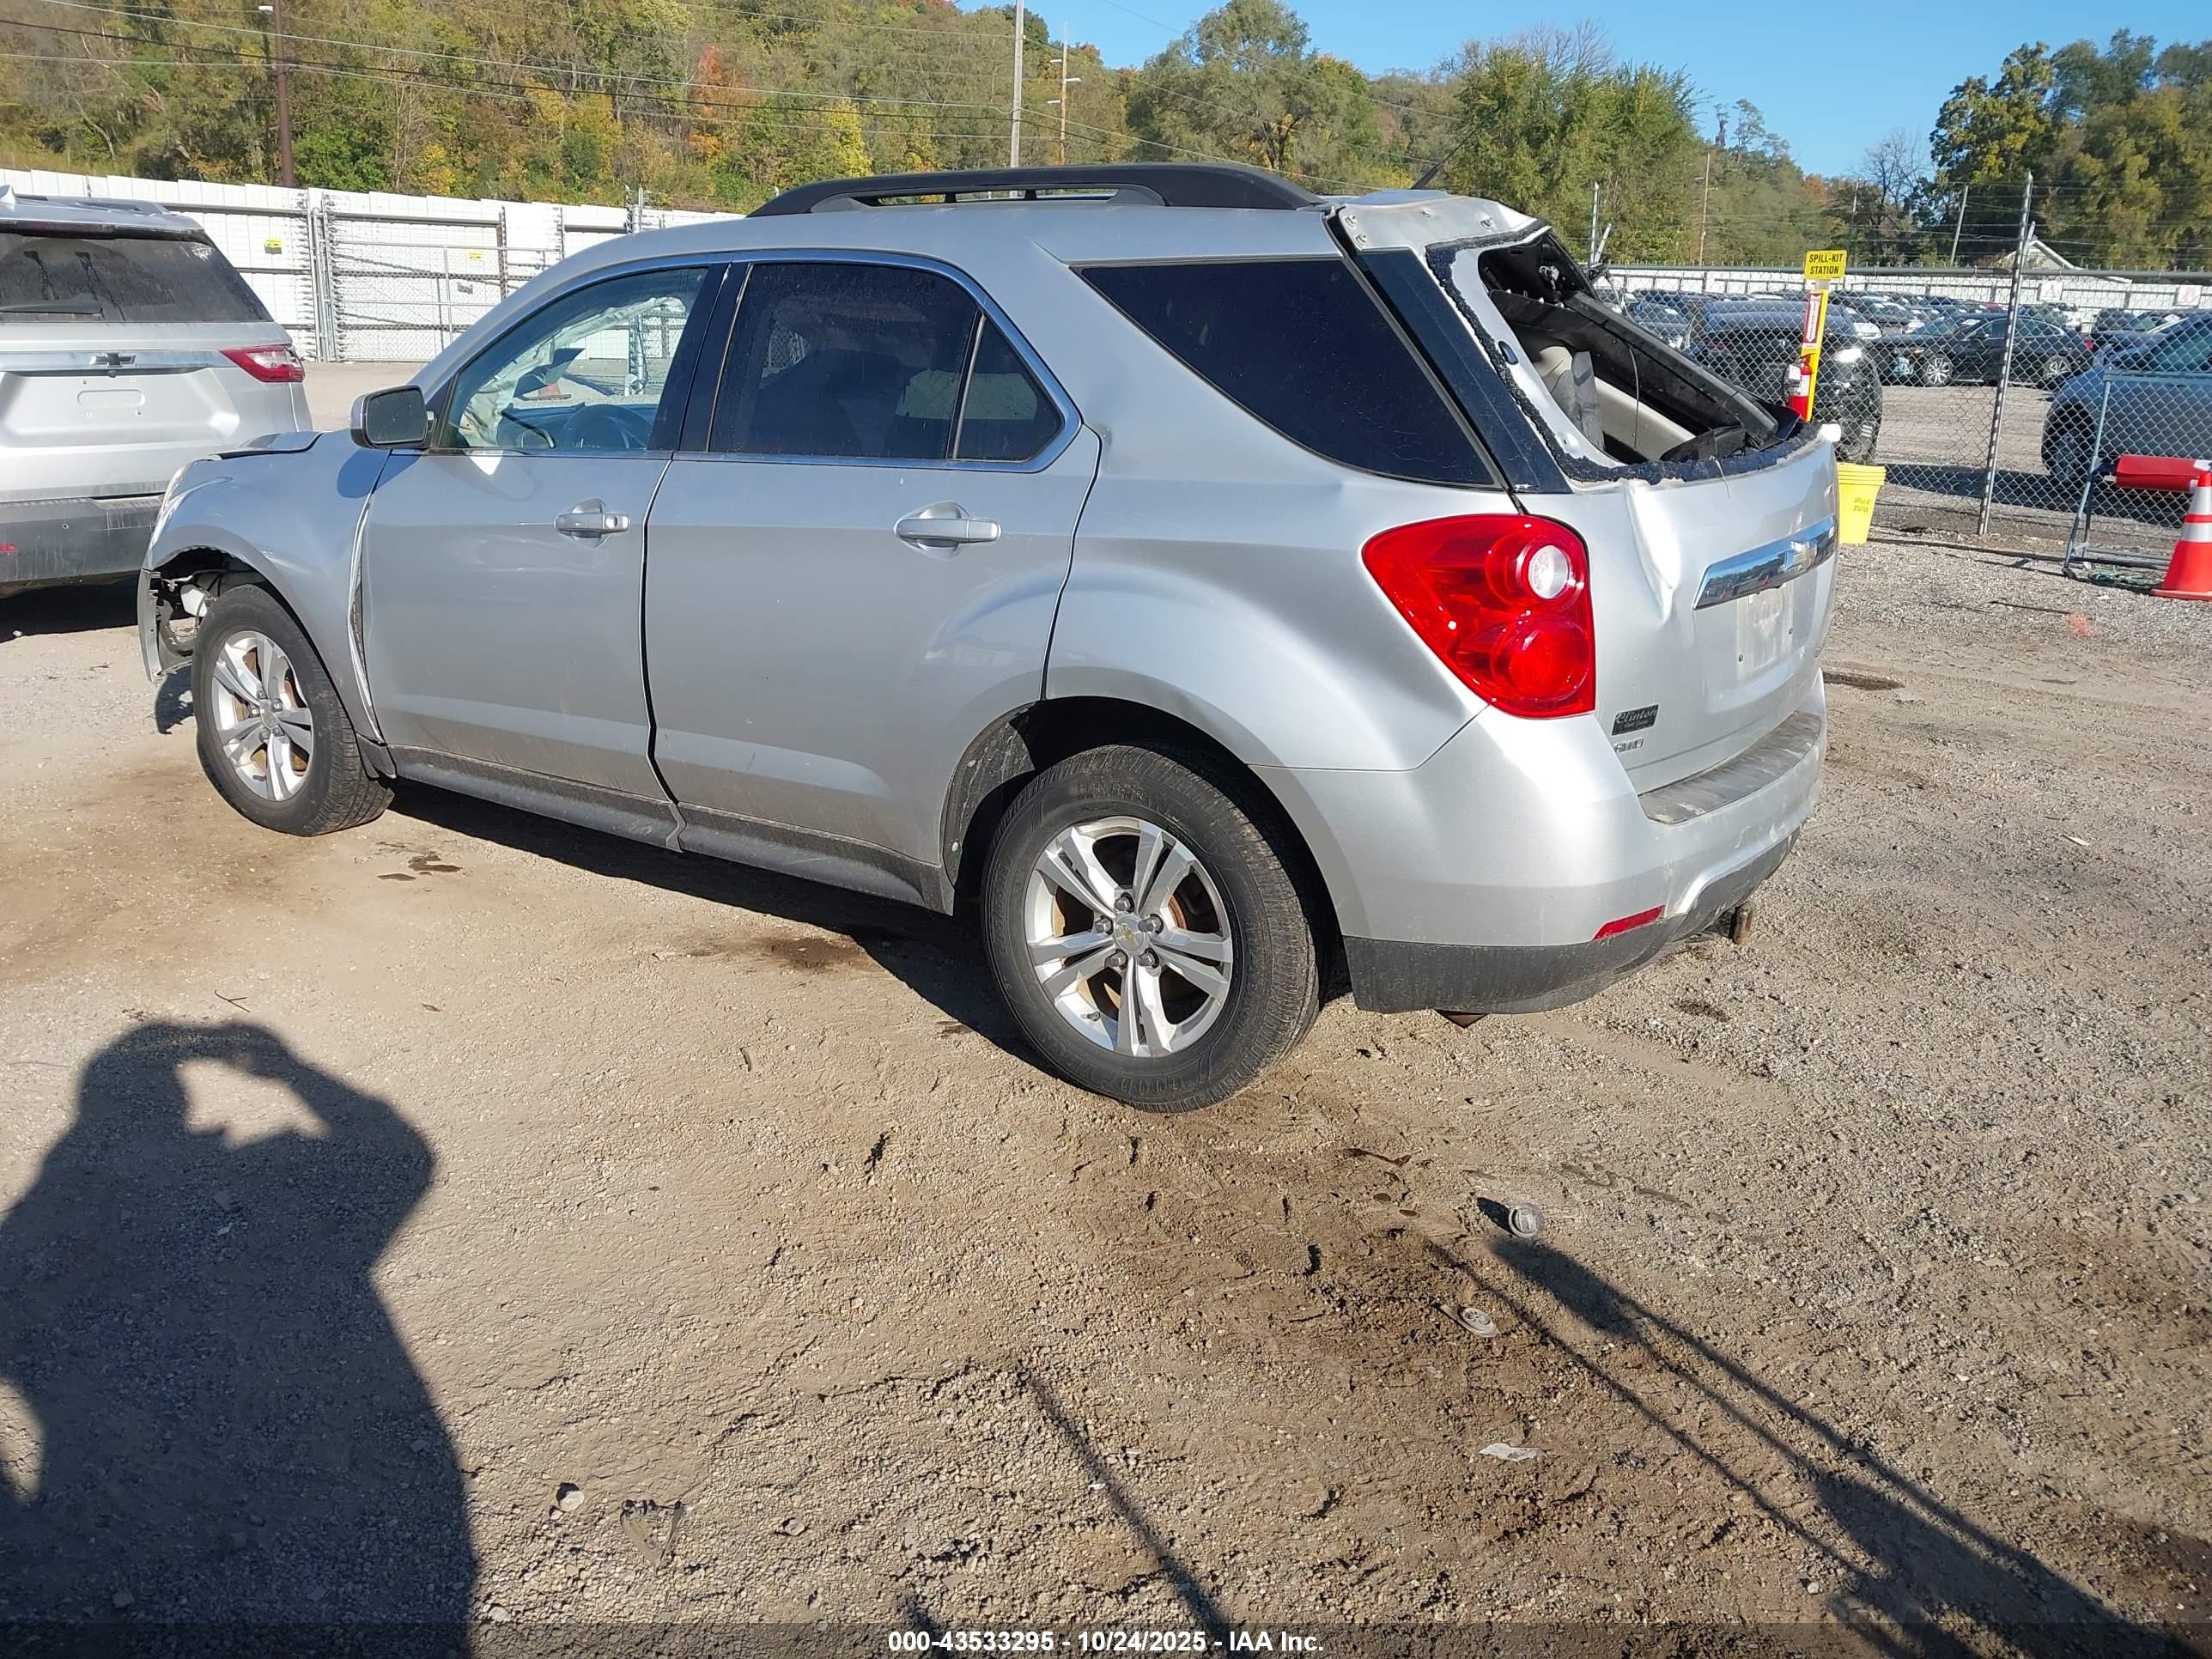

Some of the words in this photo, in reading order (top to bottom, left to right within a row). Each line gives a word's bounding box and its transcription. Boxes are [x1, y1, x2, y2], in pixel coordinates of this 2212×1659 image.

[1809, 253, 1844, 263] SPILL-KIT
[1810, 265, 1839, 275] STATION
[1615, 709, 1657, 724] Clinton
[1118, 1073, 1185, 1095] GOOD
